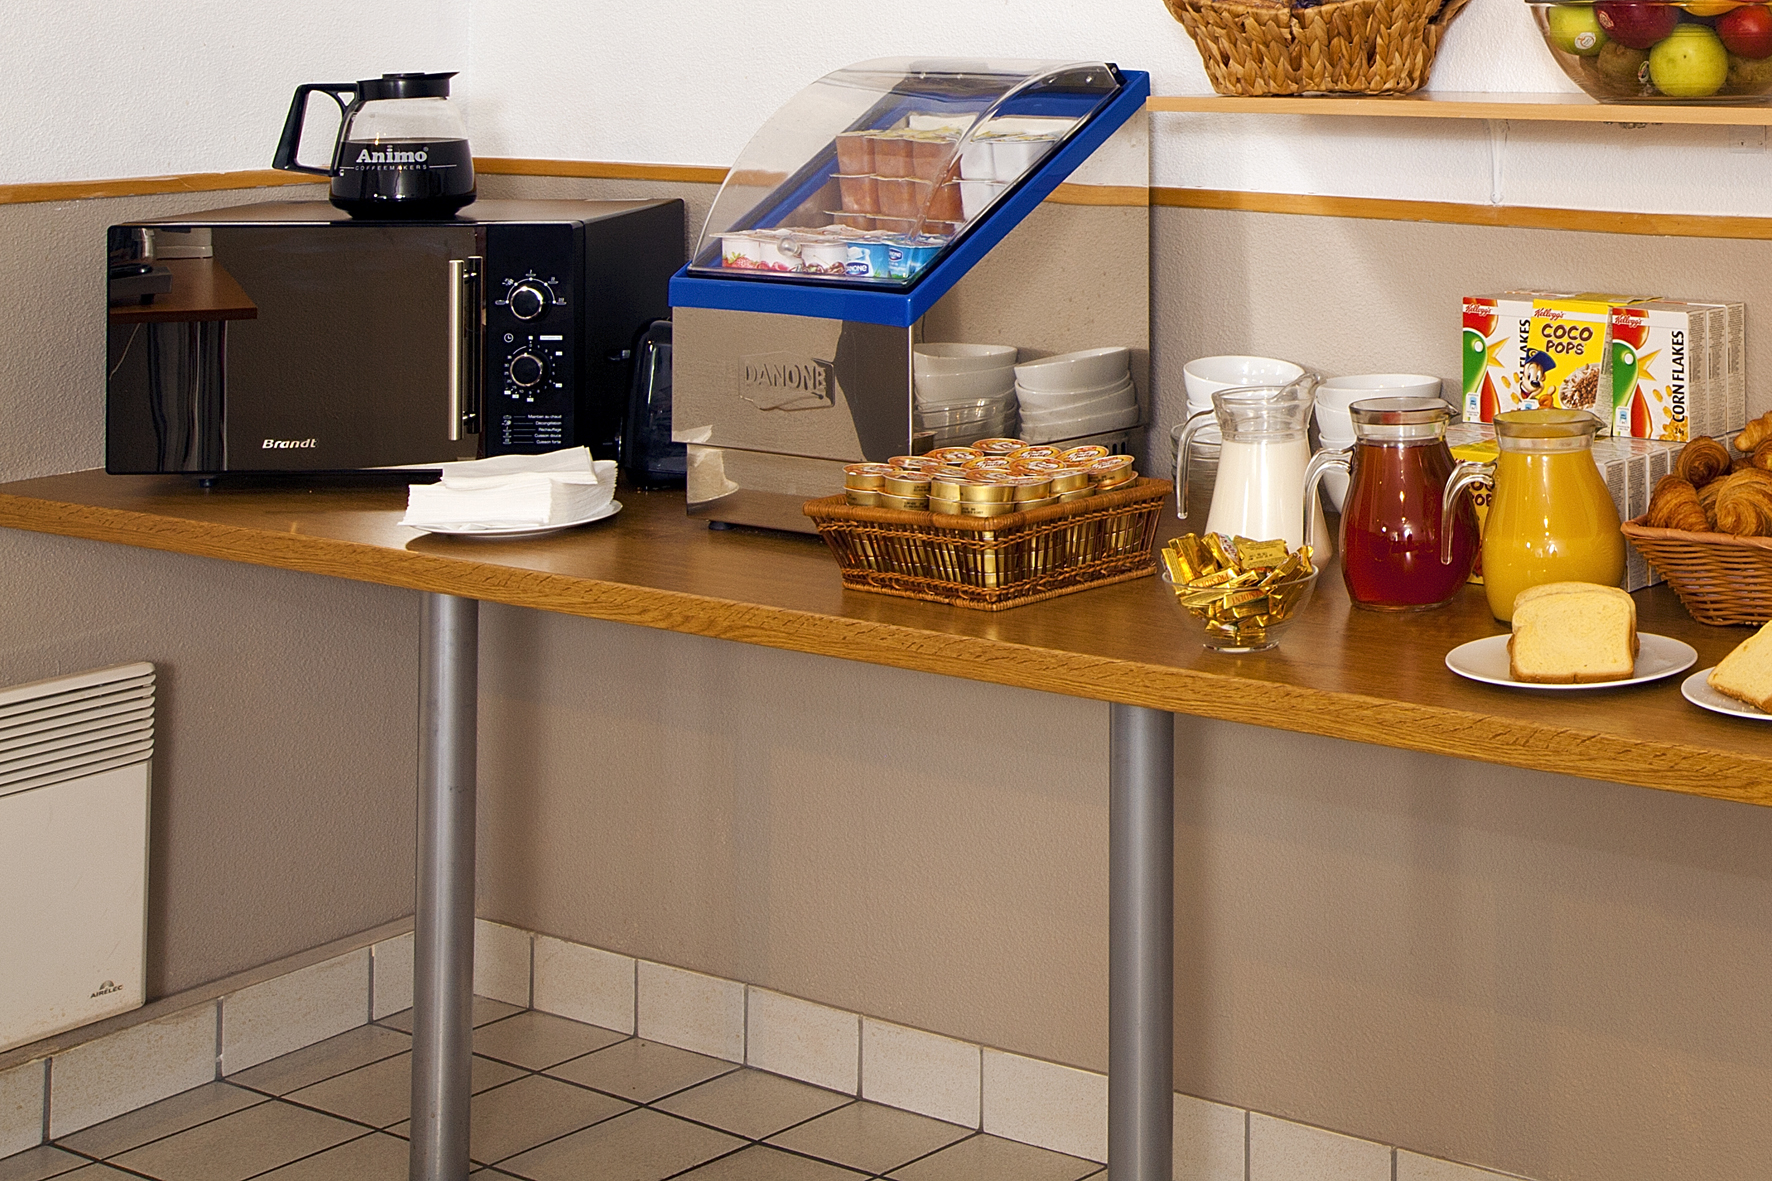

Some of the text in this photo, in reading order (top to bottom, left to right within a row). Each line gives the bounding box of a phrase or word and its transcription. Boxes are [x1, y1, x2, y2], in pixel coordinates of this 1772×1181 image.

[356, 145, 428, 163] Animo
[1464, 303, 1493, 317] Kellogg's
[1534, 307, 1565, 321] Kellogg's
[1614, 314, 1643, 328] Kellogg's
[1541, 323, 1594, 342] COCO
[1545, 340, 1585, 356] POPS
[745, 363, 827, 392] DANONE
[1671, 330, 1685, 423] CORN FLAKES
[262, 439, 317, 449] Brandt
